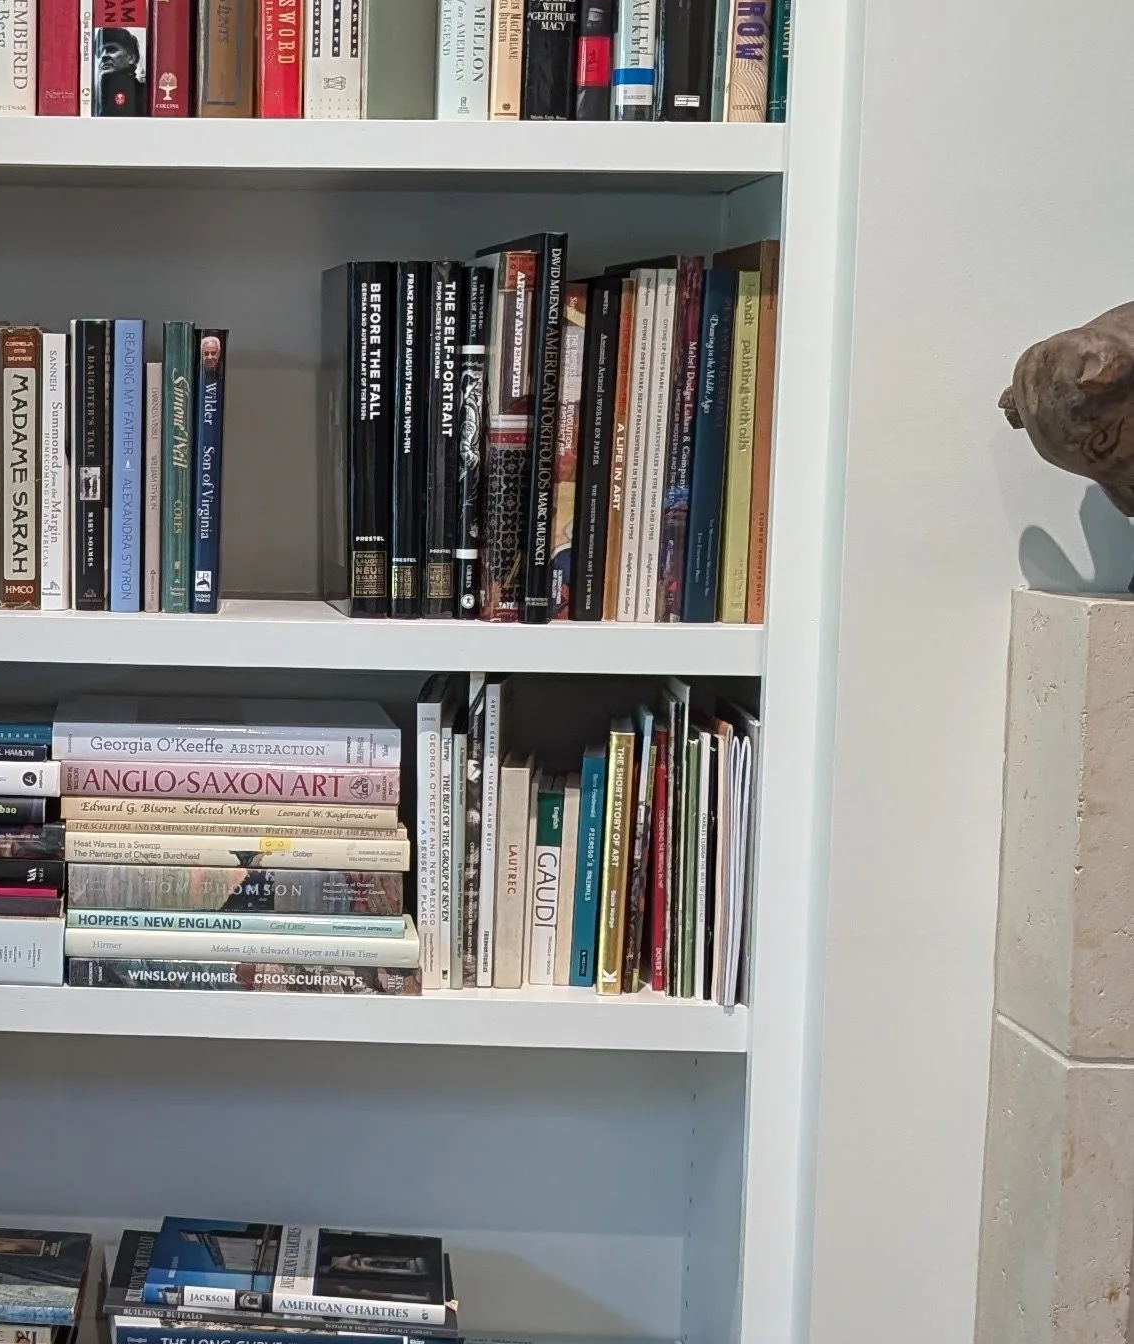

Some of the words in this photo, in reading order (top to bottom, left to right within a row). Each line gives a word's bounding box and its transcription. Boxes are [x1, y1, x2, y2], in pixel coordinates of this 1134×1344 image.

[281, 0, 295, 64] SWORD
[472, 6, 486, 83] MELLON
[370, 283, 381, 344] BEFORE
[49, 350, 57, 392] SANNEH
[370, 349, 381, 380] THE
[204, 382, 217, 425] Wilder
[370, 385, 381, 420] FALL
[12, 373, 28, 483] MADAME
[12, 491, 28, 573] SARAH
[122, 478, 133, 550] ALEXANDRA
[121, 554, 132, 600] STYRON
[82, 769, 288, 796] ANGLO-SAXON
[291, 775, 344, 798] ART
[507, 844, 518, 895] LAUTREC
[78, 914, 139, 928] HOPPER'S
[144, 915, 177, 929] NEW
[181, 915, 242, 930] ENGLAND
[128, 970, 187, 983] WINSLOW
[191, 971, 238, 984] HOMER
[254, 973, 363, 987] CROSSCURRENTS
[190, 1293, 230, 1304] JACKSON
[279, 1299, 342, 1314] AMERICAN
[346, 1303, 409, 1318] CHARTRES
